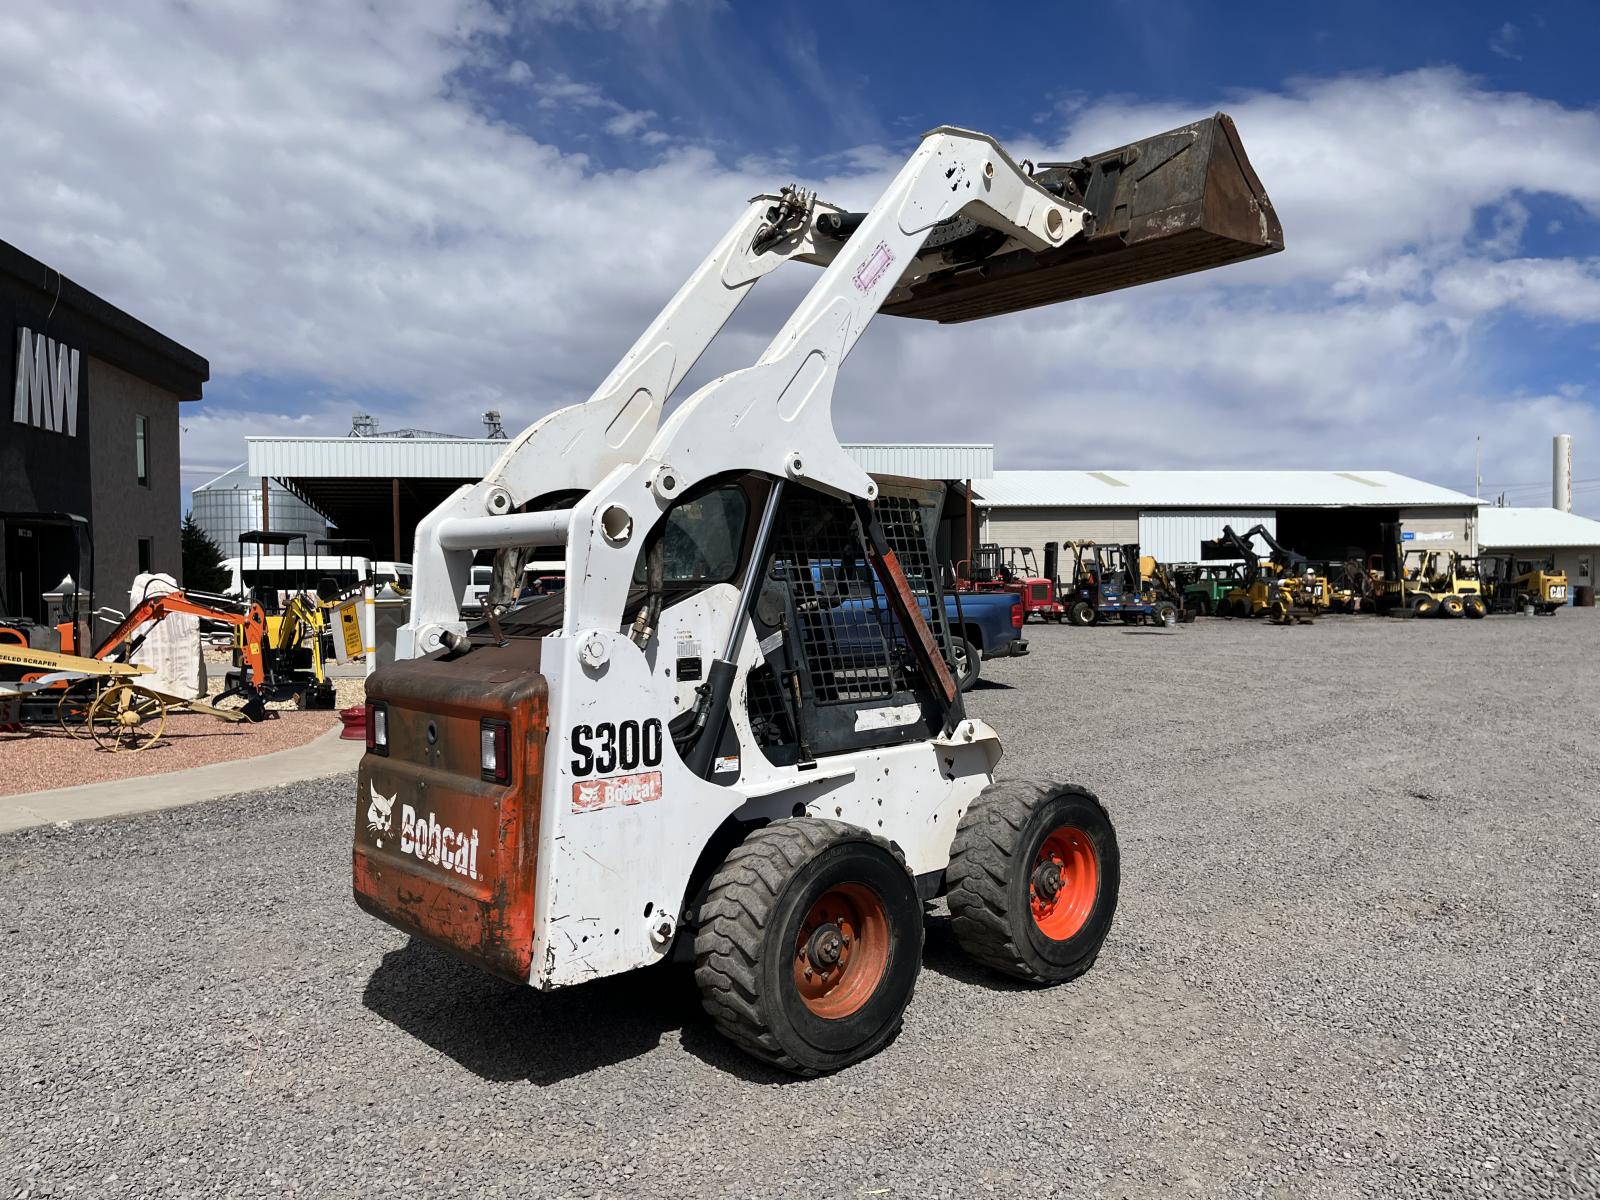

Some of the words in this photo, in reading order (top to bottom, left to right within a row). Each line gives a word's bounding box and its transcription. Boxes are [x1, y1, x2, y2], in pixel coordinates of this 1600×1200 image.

[13, 326, 80, 437] MW
[1549, 586, 1566, 598] CAT
[23, 657, 58, 667] SCRAPER
[571, 718, 662, 777] S300
[604, 780, 655, 803] Bobcat
[401, 804, 479, 880] Bobcat
